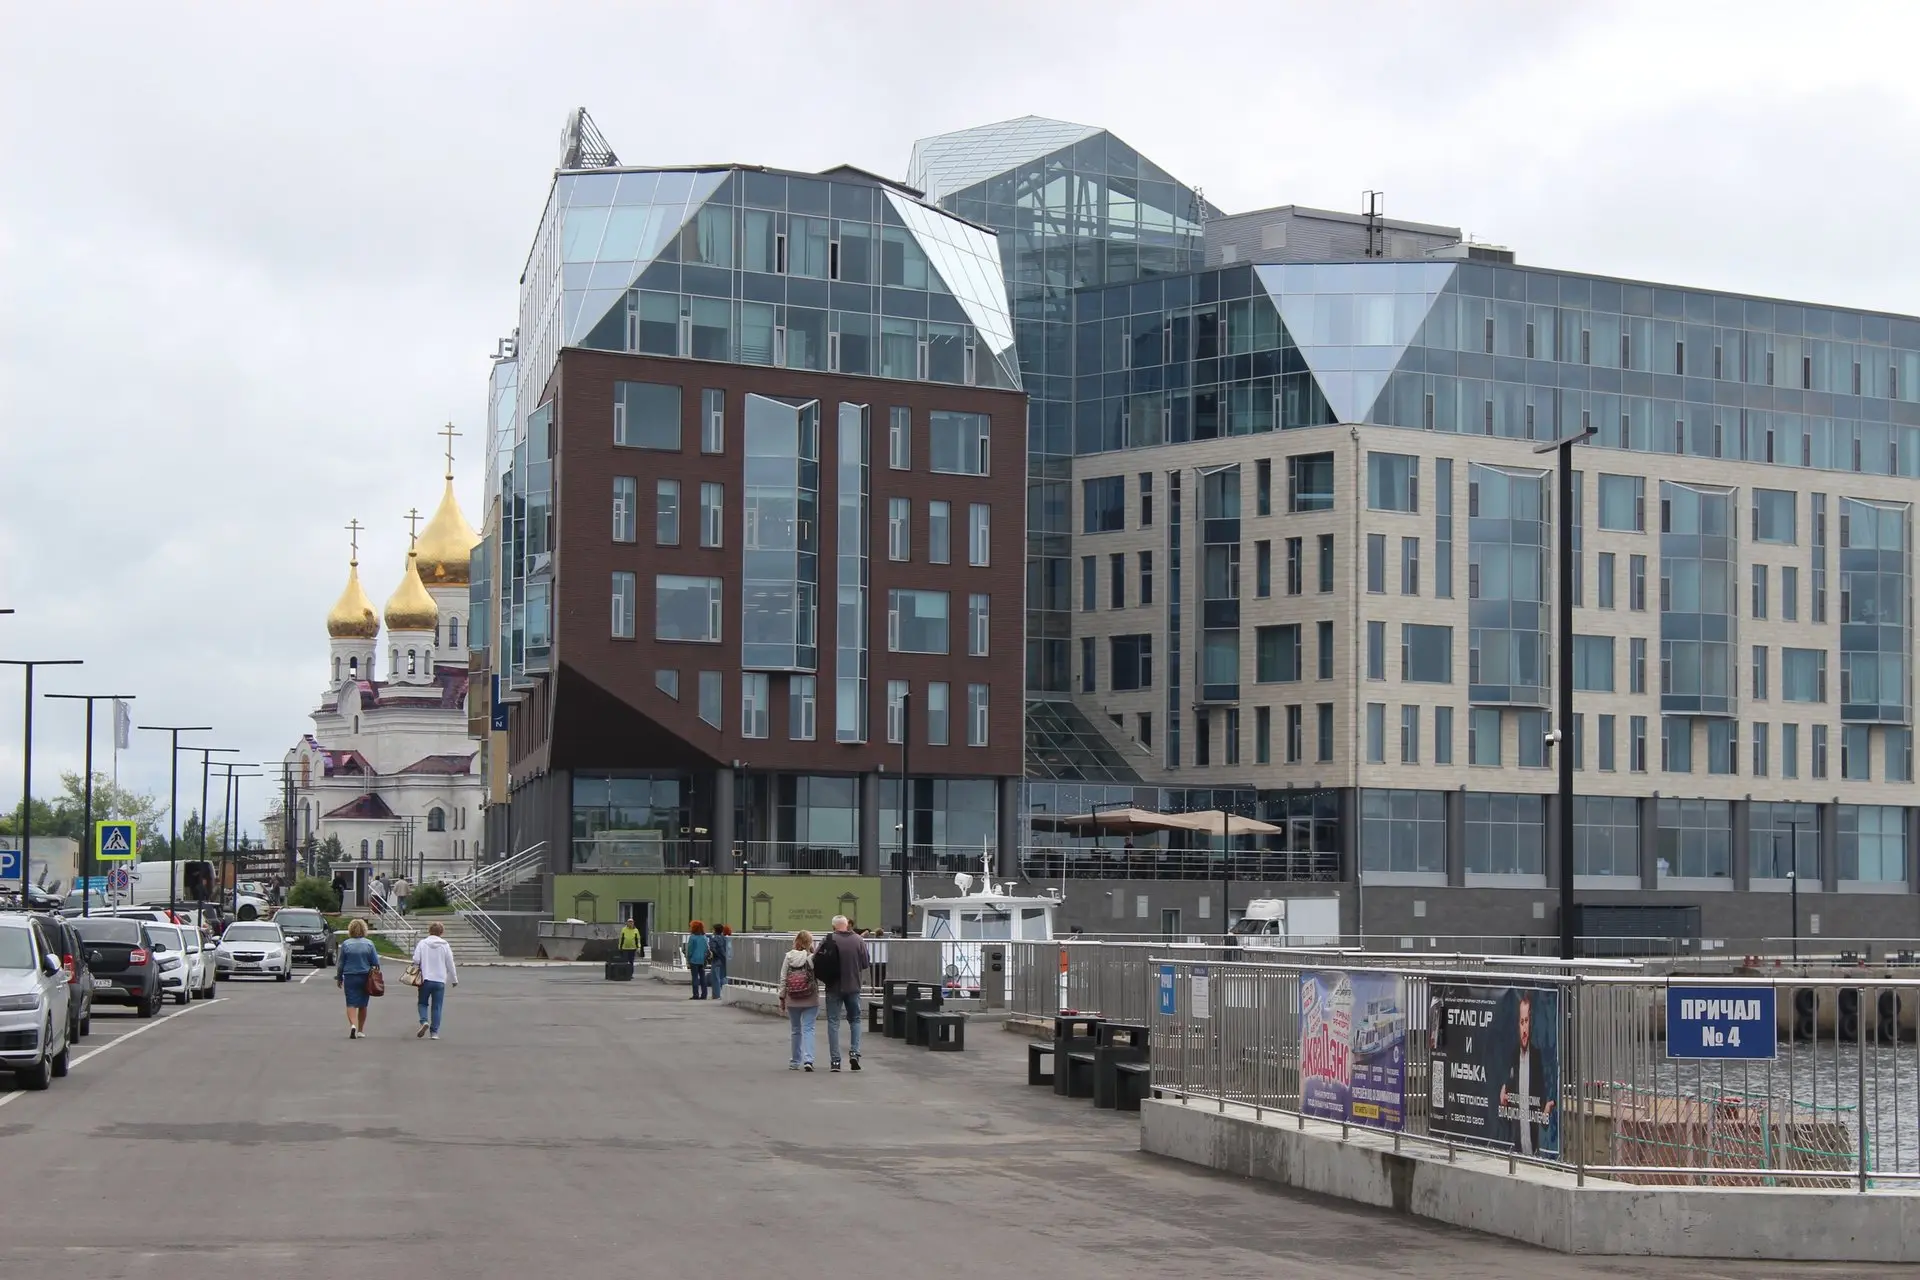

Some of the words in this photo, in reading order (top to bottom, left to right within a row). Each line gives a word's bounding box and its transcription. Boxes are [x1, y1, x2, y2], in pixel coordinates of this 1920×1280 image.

[0, 853, 15, 876] P
[1447, 1008, 1477, 1027] STAND
[1479, 1010, 1493, 1028] UP
[1680, 999, 1761, 1021] ПРИЧАЛ
[1465, 1036, 1473, 1054] И
[1702, 1026, 1724, 1047] №
[1727, 1026, 1741, 1048] 4
[1450, 1062, 1487, 1082] МУЗЫКА
[1448, 1092, 1456, 1103] НА
[1456, 1093, 1489, 1107] ТЕПЛОХОДЕ
